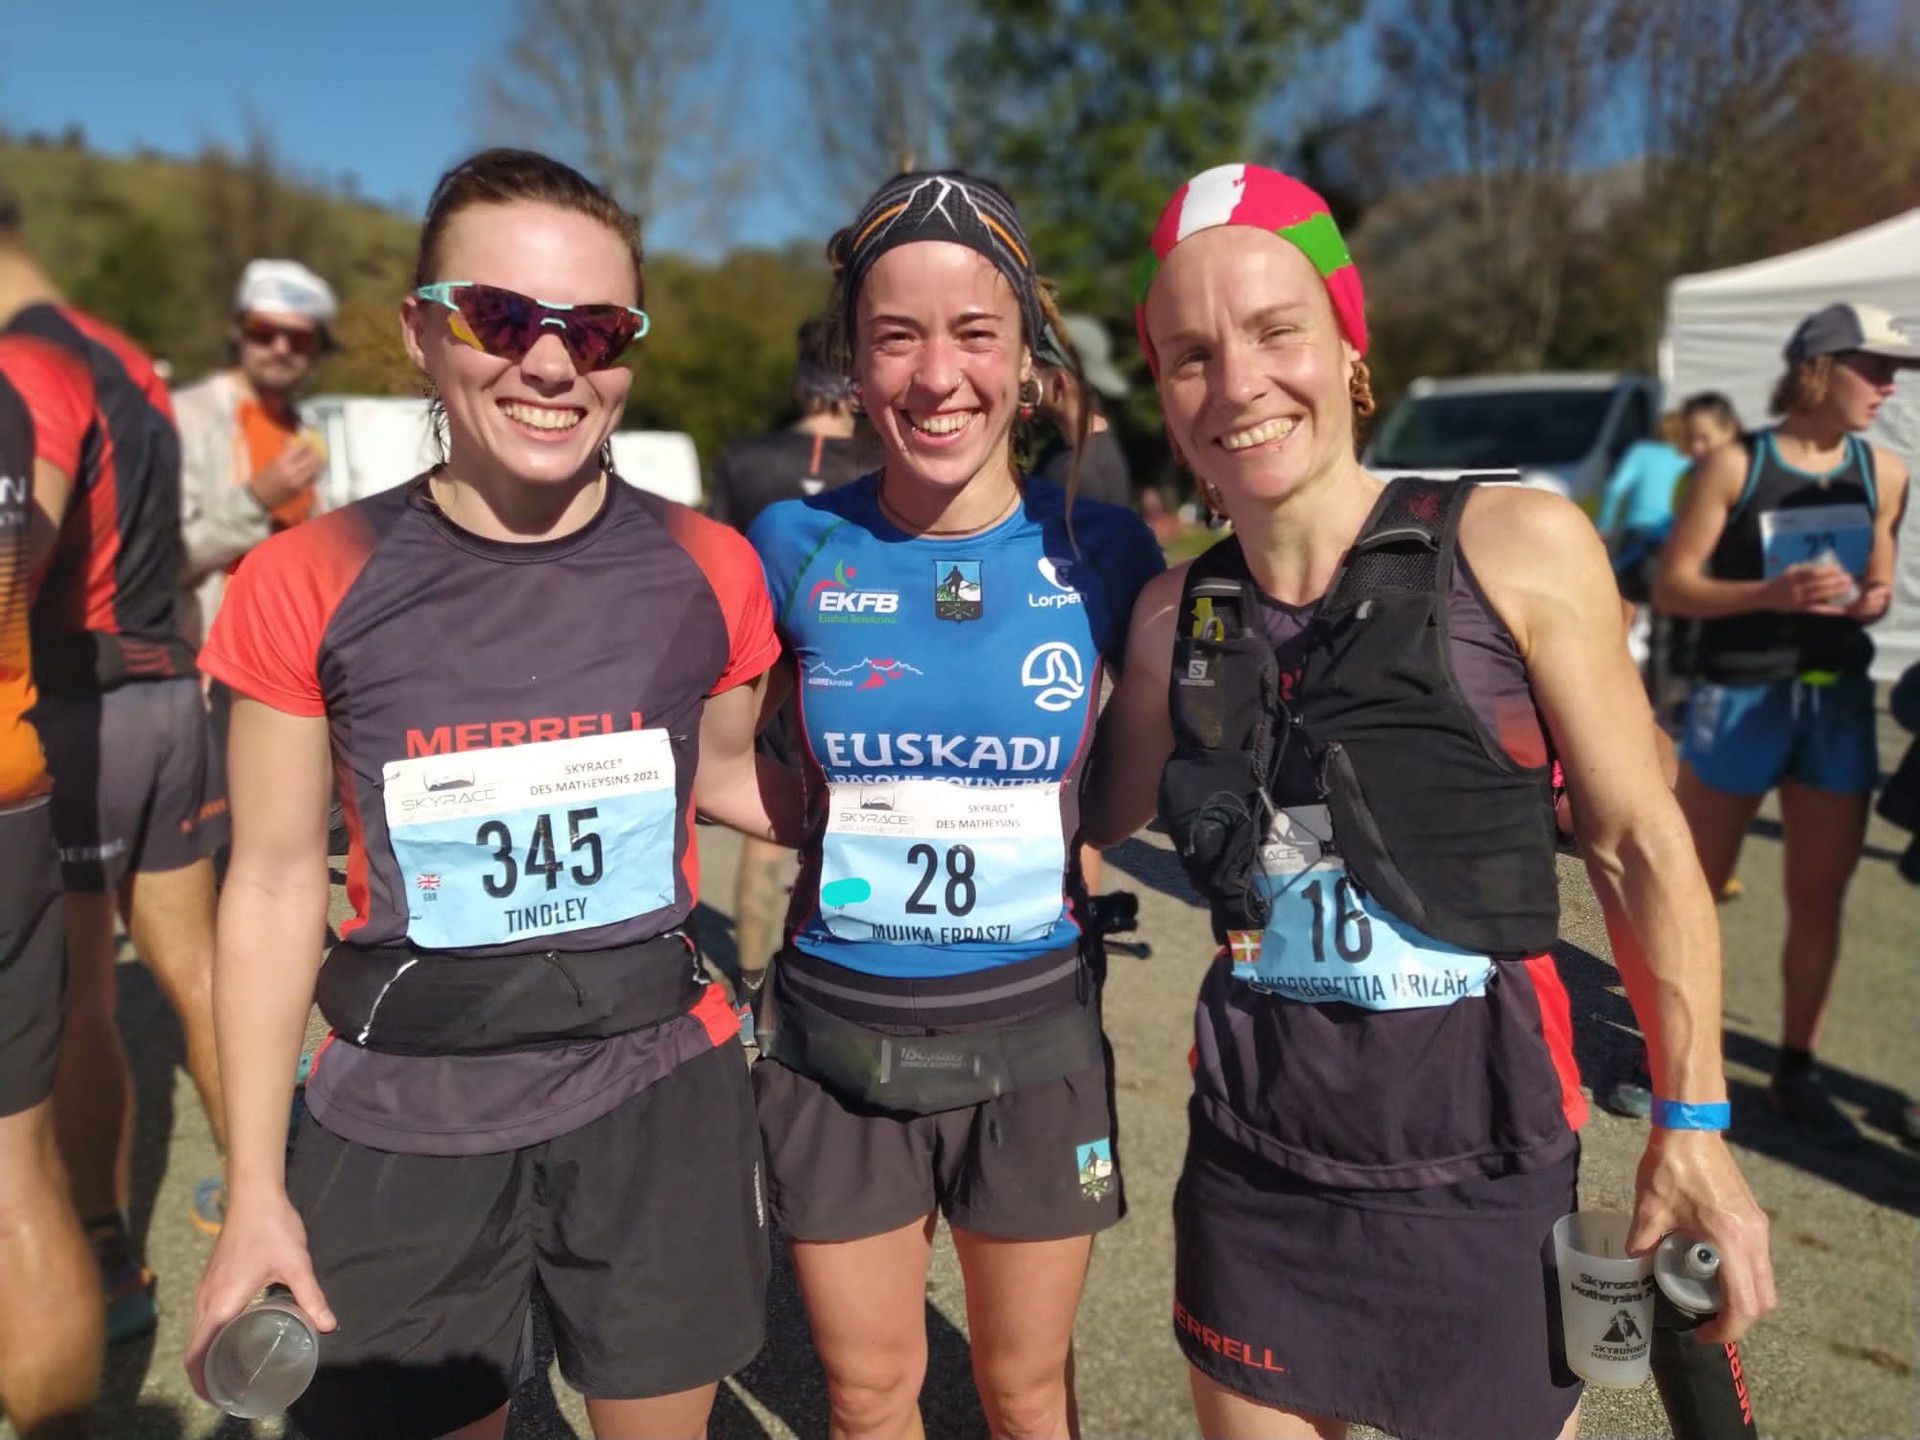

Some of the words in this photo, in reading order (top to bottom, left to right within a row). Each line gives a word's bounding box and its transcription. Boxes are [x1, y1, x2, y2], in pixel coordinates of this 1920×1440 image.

[819, 591, 899, 613] EKFB
[823, 732, 1061, 771] EUSKADI
[530, 785, 553, 796] DES
[555, 774, 631, 792] MATHEYSINS
[633, 770, 659, 783] 2021
[401, 788, 497, 811] SKYRACE
[839, 812, 909, 826] SKYRACE
[936, 819, 956, 829] DES
[958, 818, 1021, 829] MATHEYSINS
[475, 806, 604, 899] 345
[905, 843, 977, 917] 28
[503, 896, 589, 933] TINDLEY
[1302, 876, 1373, 963] 16
[871, 923, 934, 943] MUJIKA
[1580, 1273, 1639, 1290] Skyrace
[1173, 1299, 1285, 1374] ERRELL
